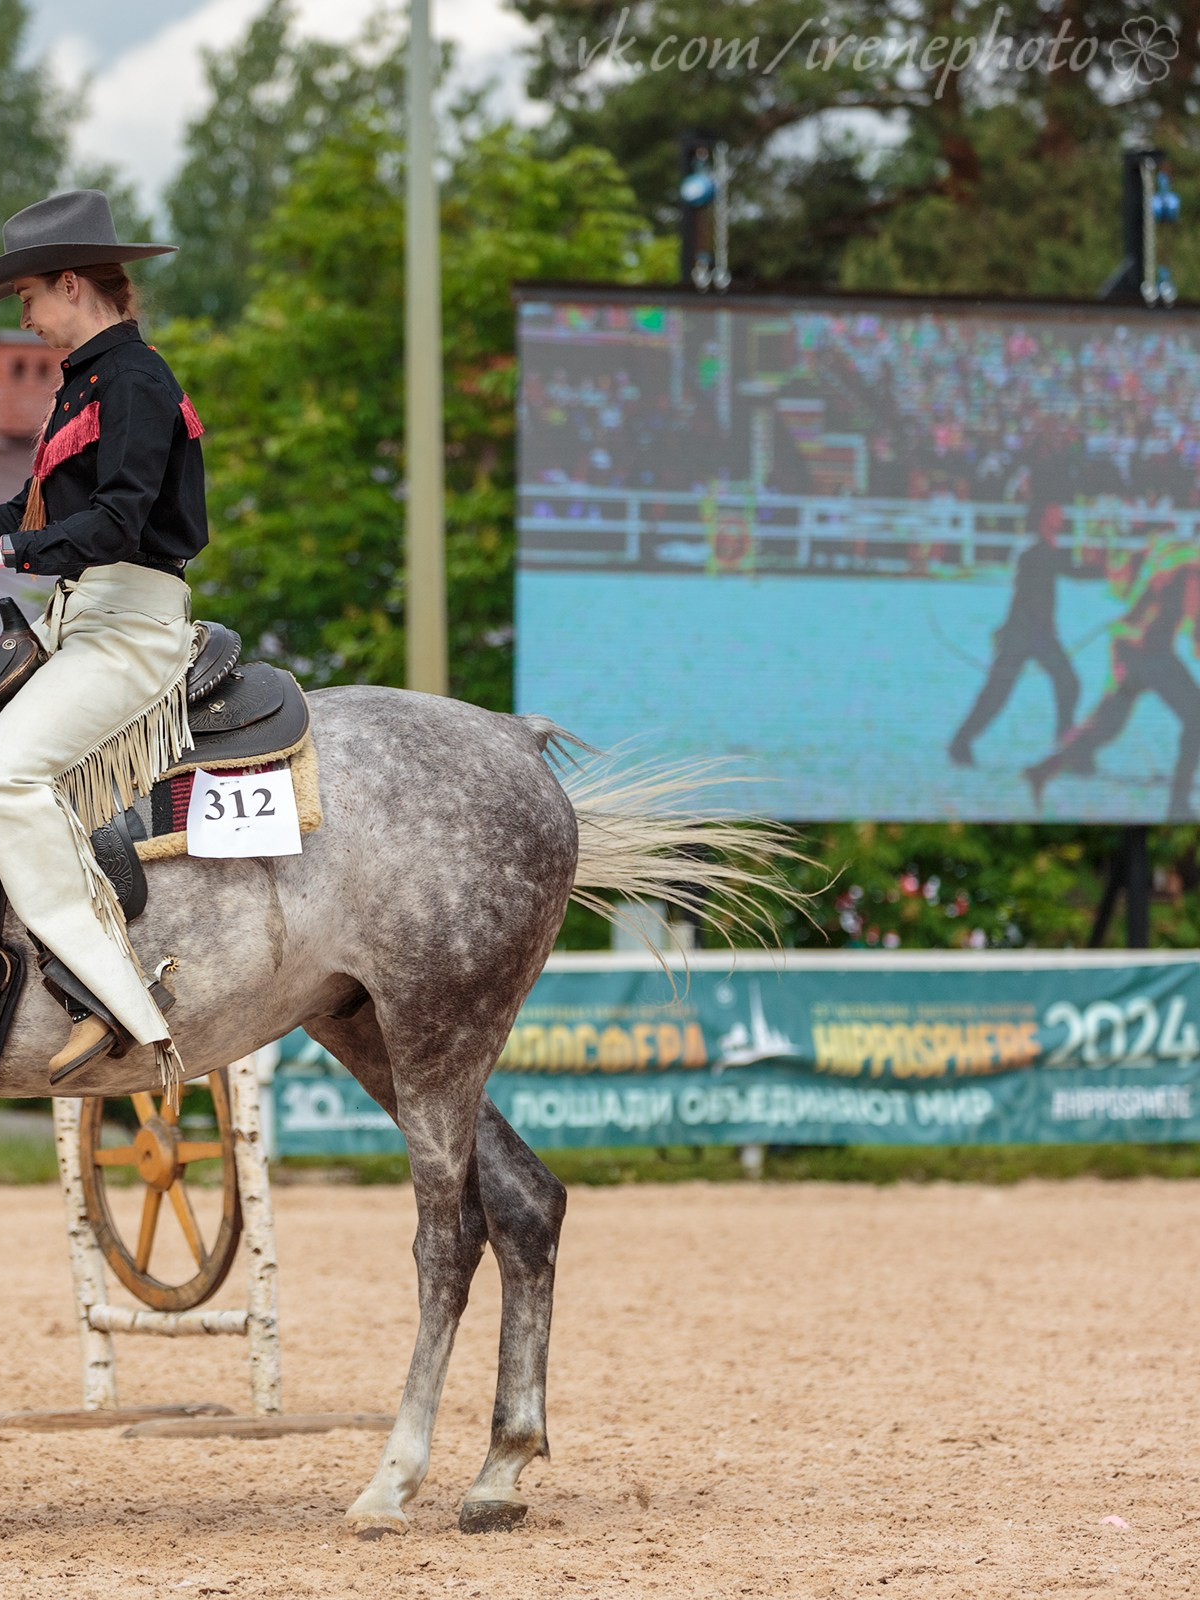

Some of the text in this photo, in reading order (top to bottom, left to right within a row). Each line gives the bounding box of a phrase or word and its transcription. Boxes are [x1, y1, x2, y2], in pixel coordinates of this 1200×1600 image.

[204, 787, 276, 821] 312
[812, 1021, 1042, 1078] HIPPOSPHERE
[1043, 996, 1200, 1069] 2024
[511, 1083, 995, 1132] ЛОШАДИ ОБЪЕДИНЯЮТ МИР
[1051, 1085, 1193, 1121] #HIPPOSPHERE
